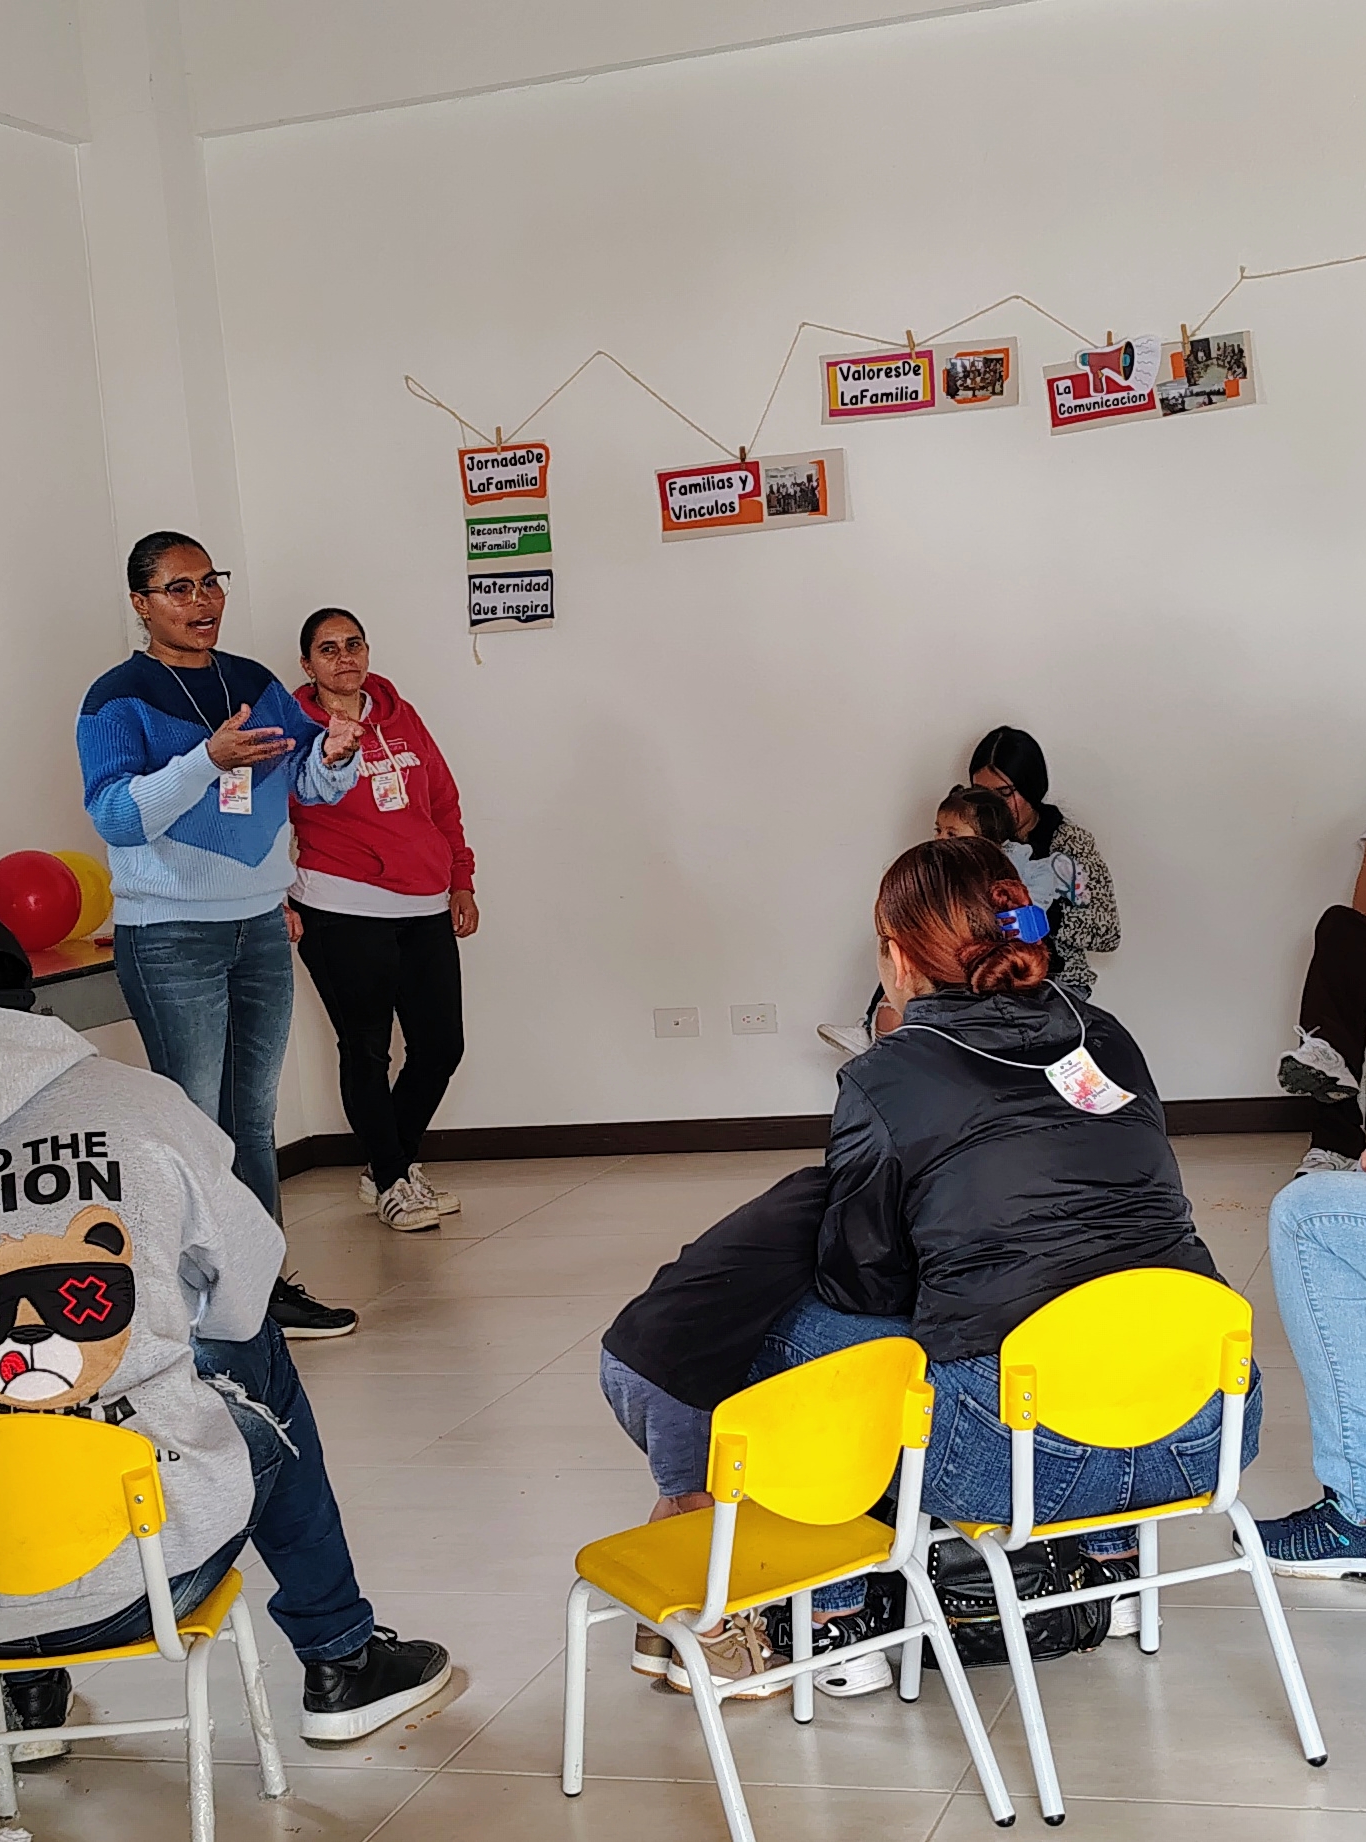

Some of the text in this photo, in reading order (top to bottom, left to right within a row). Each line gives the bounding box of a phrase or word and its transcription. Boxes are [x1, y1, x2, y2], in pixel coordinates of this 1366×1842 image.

[839, 360, 922, 382] ValoresDe
[840, 386, 919, 407] LaFamilia
[1056, 383, 1072, 396] La
[1058, 391, 1147, 416] Comunicacion
[466, 450, 544, 471] JornadaDe
[469, 473, 538, 494] LaFamilia
[668, 476, 734, 497] Familias
[671, 500, 736, 521] Vinculos
[470, 520, 546, 537] Reconstruyendo
[470, 539, 517, 552] MiFamilia
[472, 578, 549, 595] Maternidad
[472, 600, 549, 618] Que inspira
[22, 1131, 109, 1165] THE
